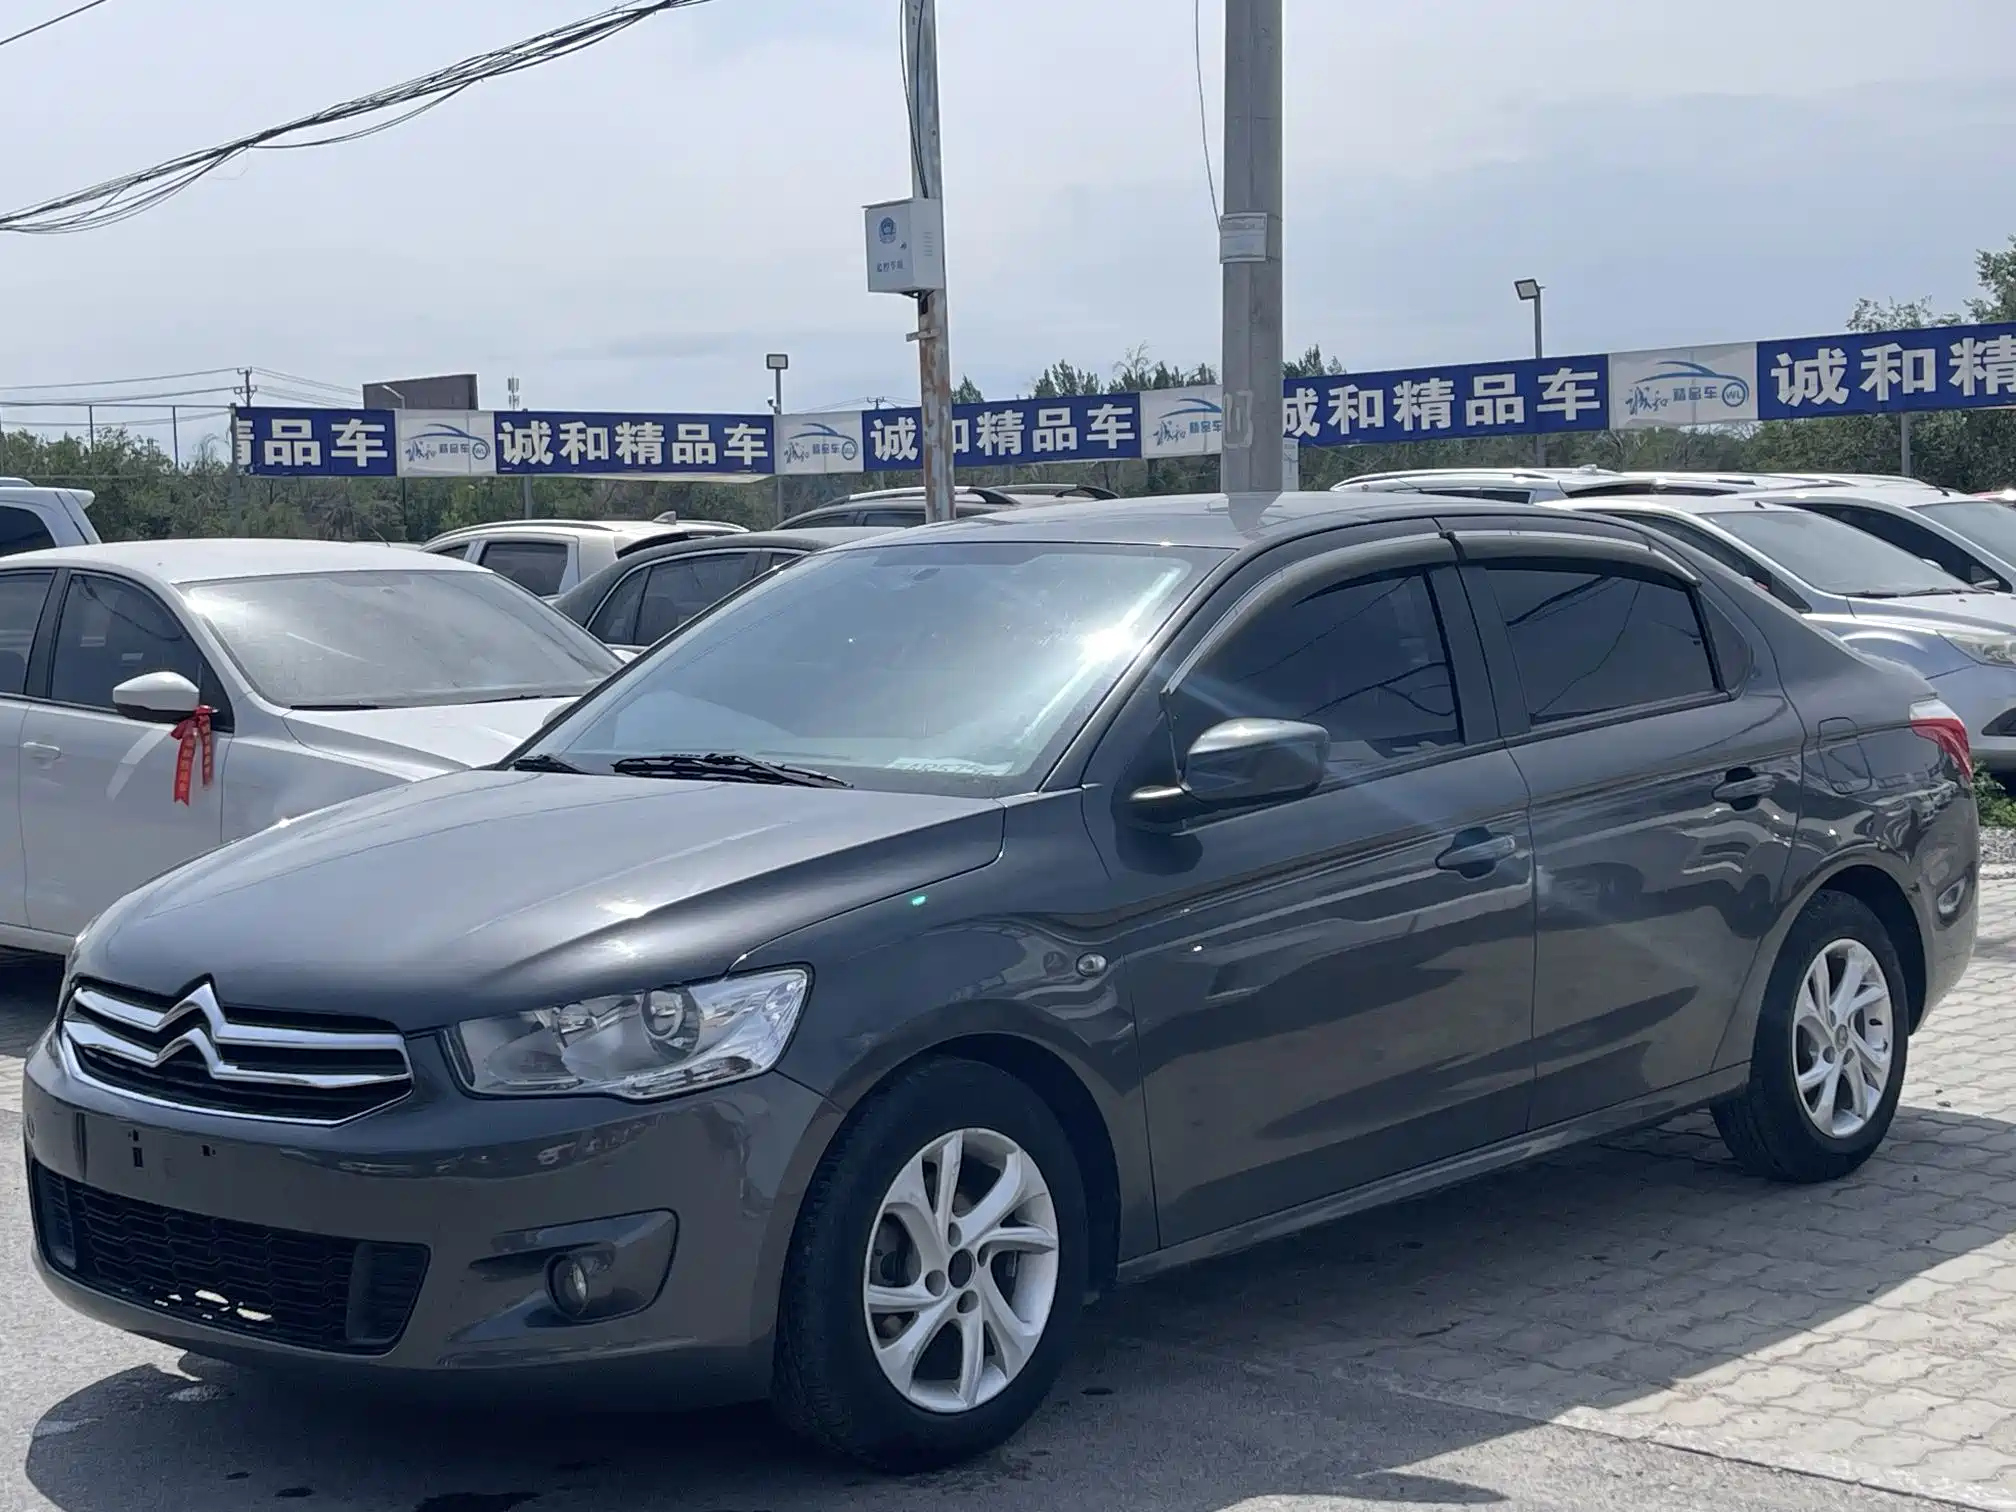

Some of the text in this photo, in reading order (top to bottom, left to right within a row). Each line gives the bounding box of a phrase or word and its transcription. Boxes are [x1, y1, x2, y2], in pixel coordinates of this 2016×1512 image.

[1770, 334, 2016, 407] 诚和精
[497, 420, 769, 466] 诚和精品车
